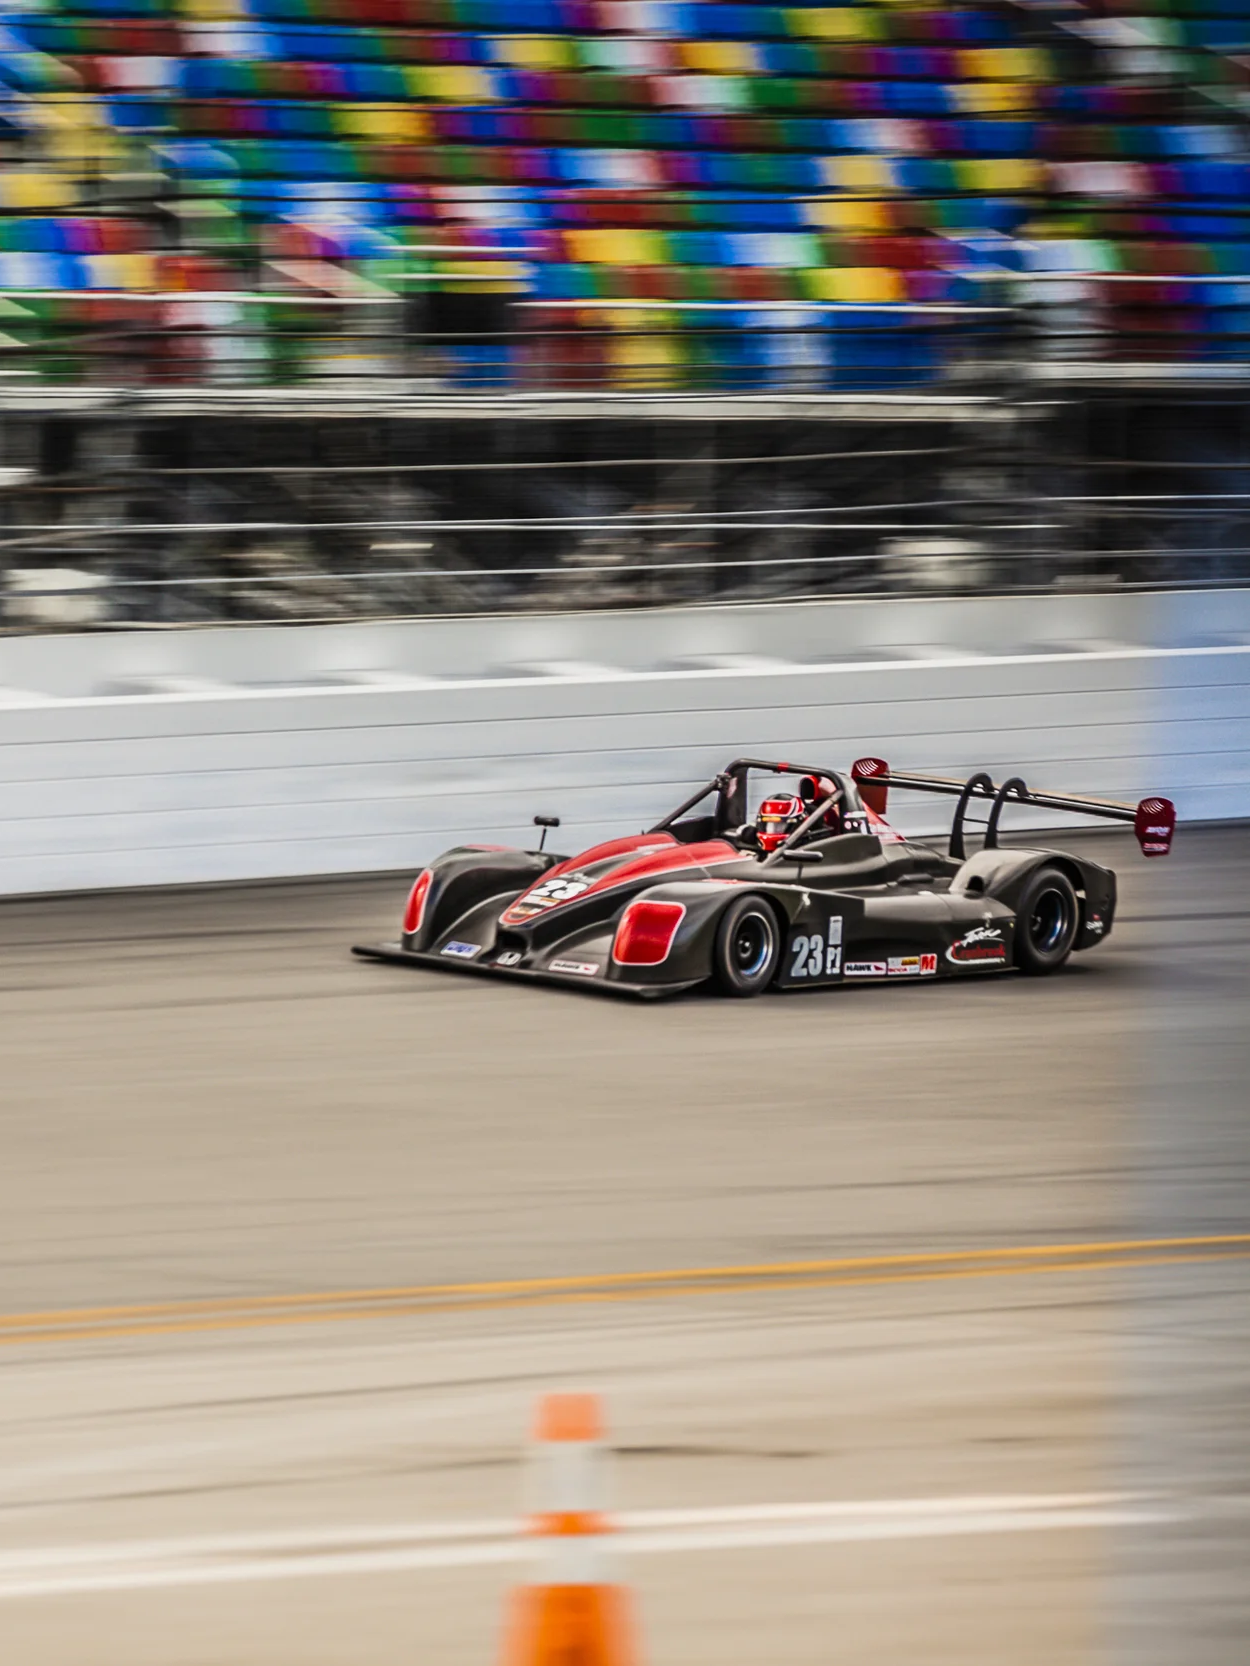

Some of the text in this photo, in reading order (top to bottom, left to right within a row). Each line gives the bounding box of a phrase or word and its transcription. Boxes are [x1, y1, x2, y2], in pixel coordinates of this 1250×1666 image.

[529, 879, 588, 899] 23
[791, 934, 824, 977] 23
[921, 955, 936, 971] M
[846, 964, 872, 972] HAWK
